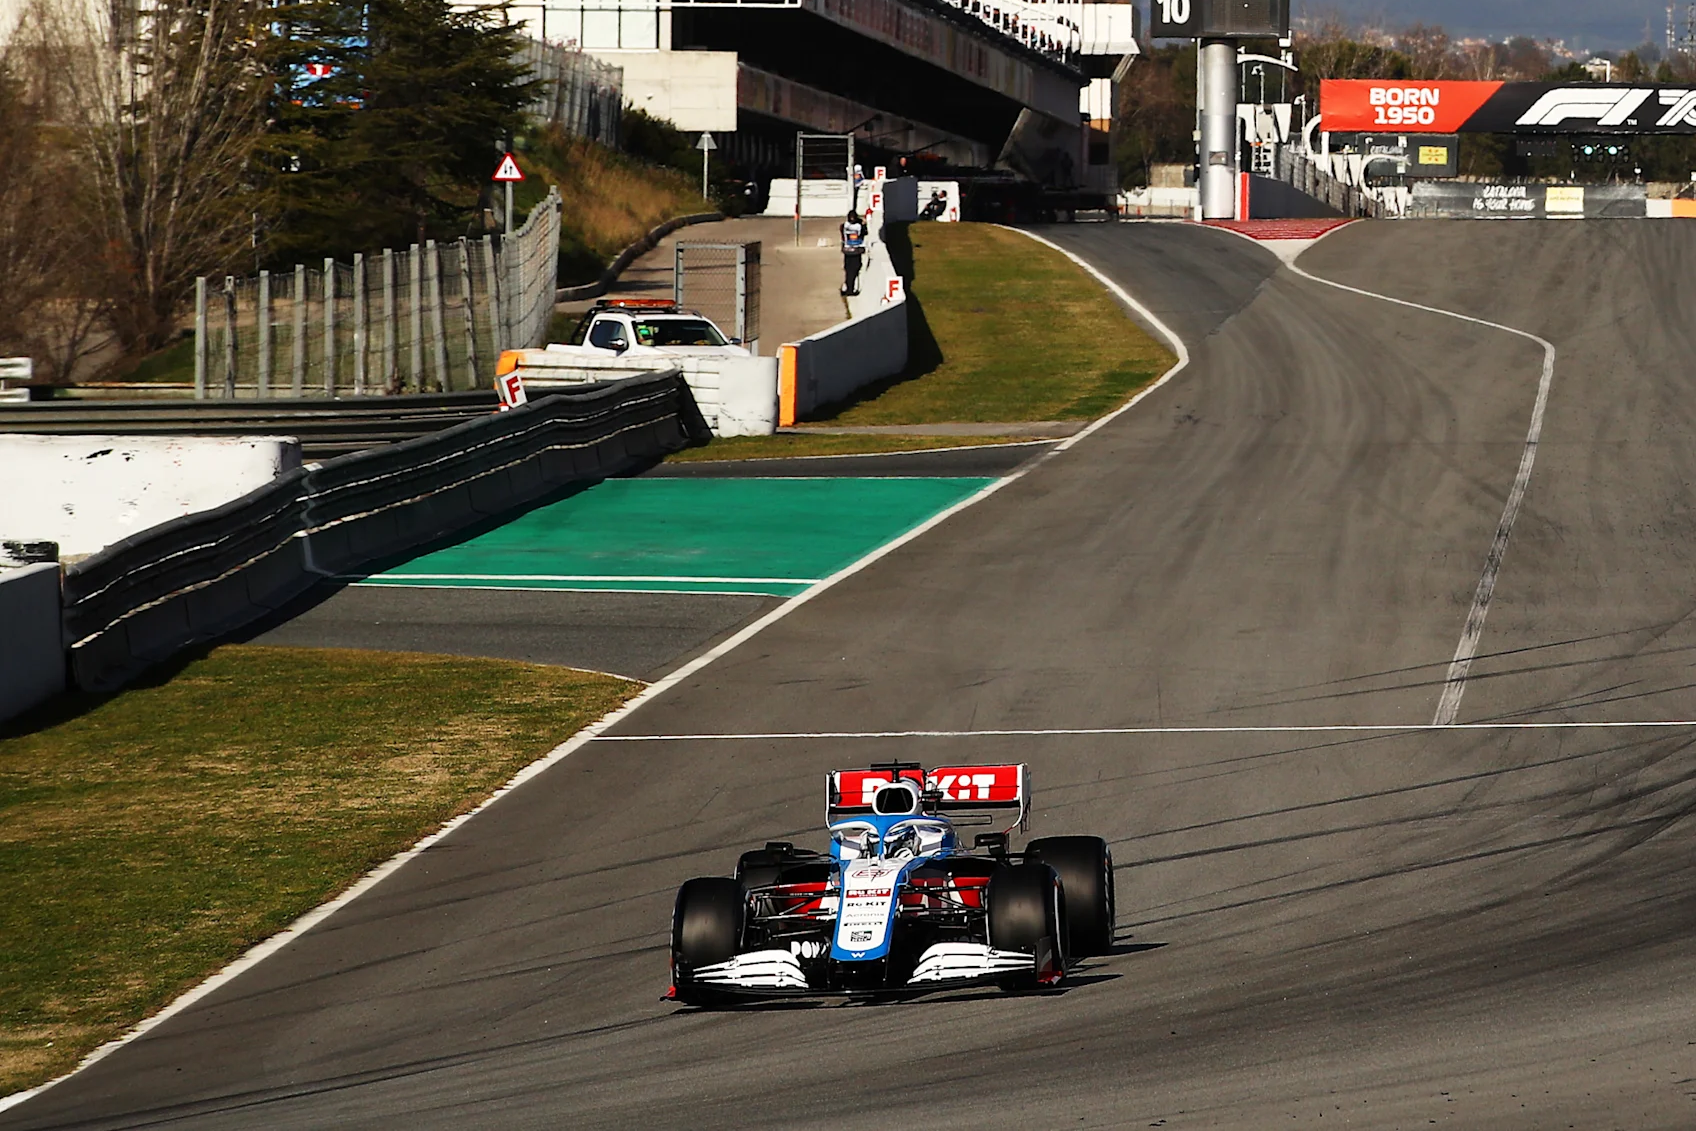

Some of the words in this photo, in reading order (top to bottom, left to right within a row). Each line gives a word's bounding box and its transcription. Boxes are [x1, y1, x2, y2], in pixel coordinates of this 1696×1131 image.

[1369, 87, 1440, 106] BORN
[1373, 105, 1436, 125] 1950
[1515, 88, 1654, 126] F1
[877, 169, 884, 180] F
[872, 194, 881, 208] F
[888, 279, 900, 298] F
[505, 374, 521, 405] F
